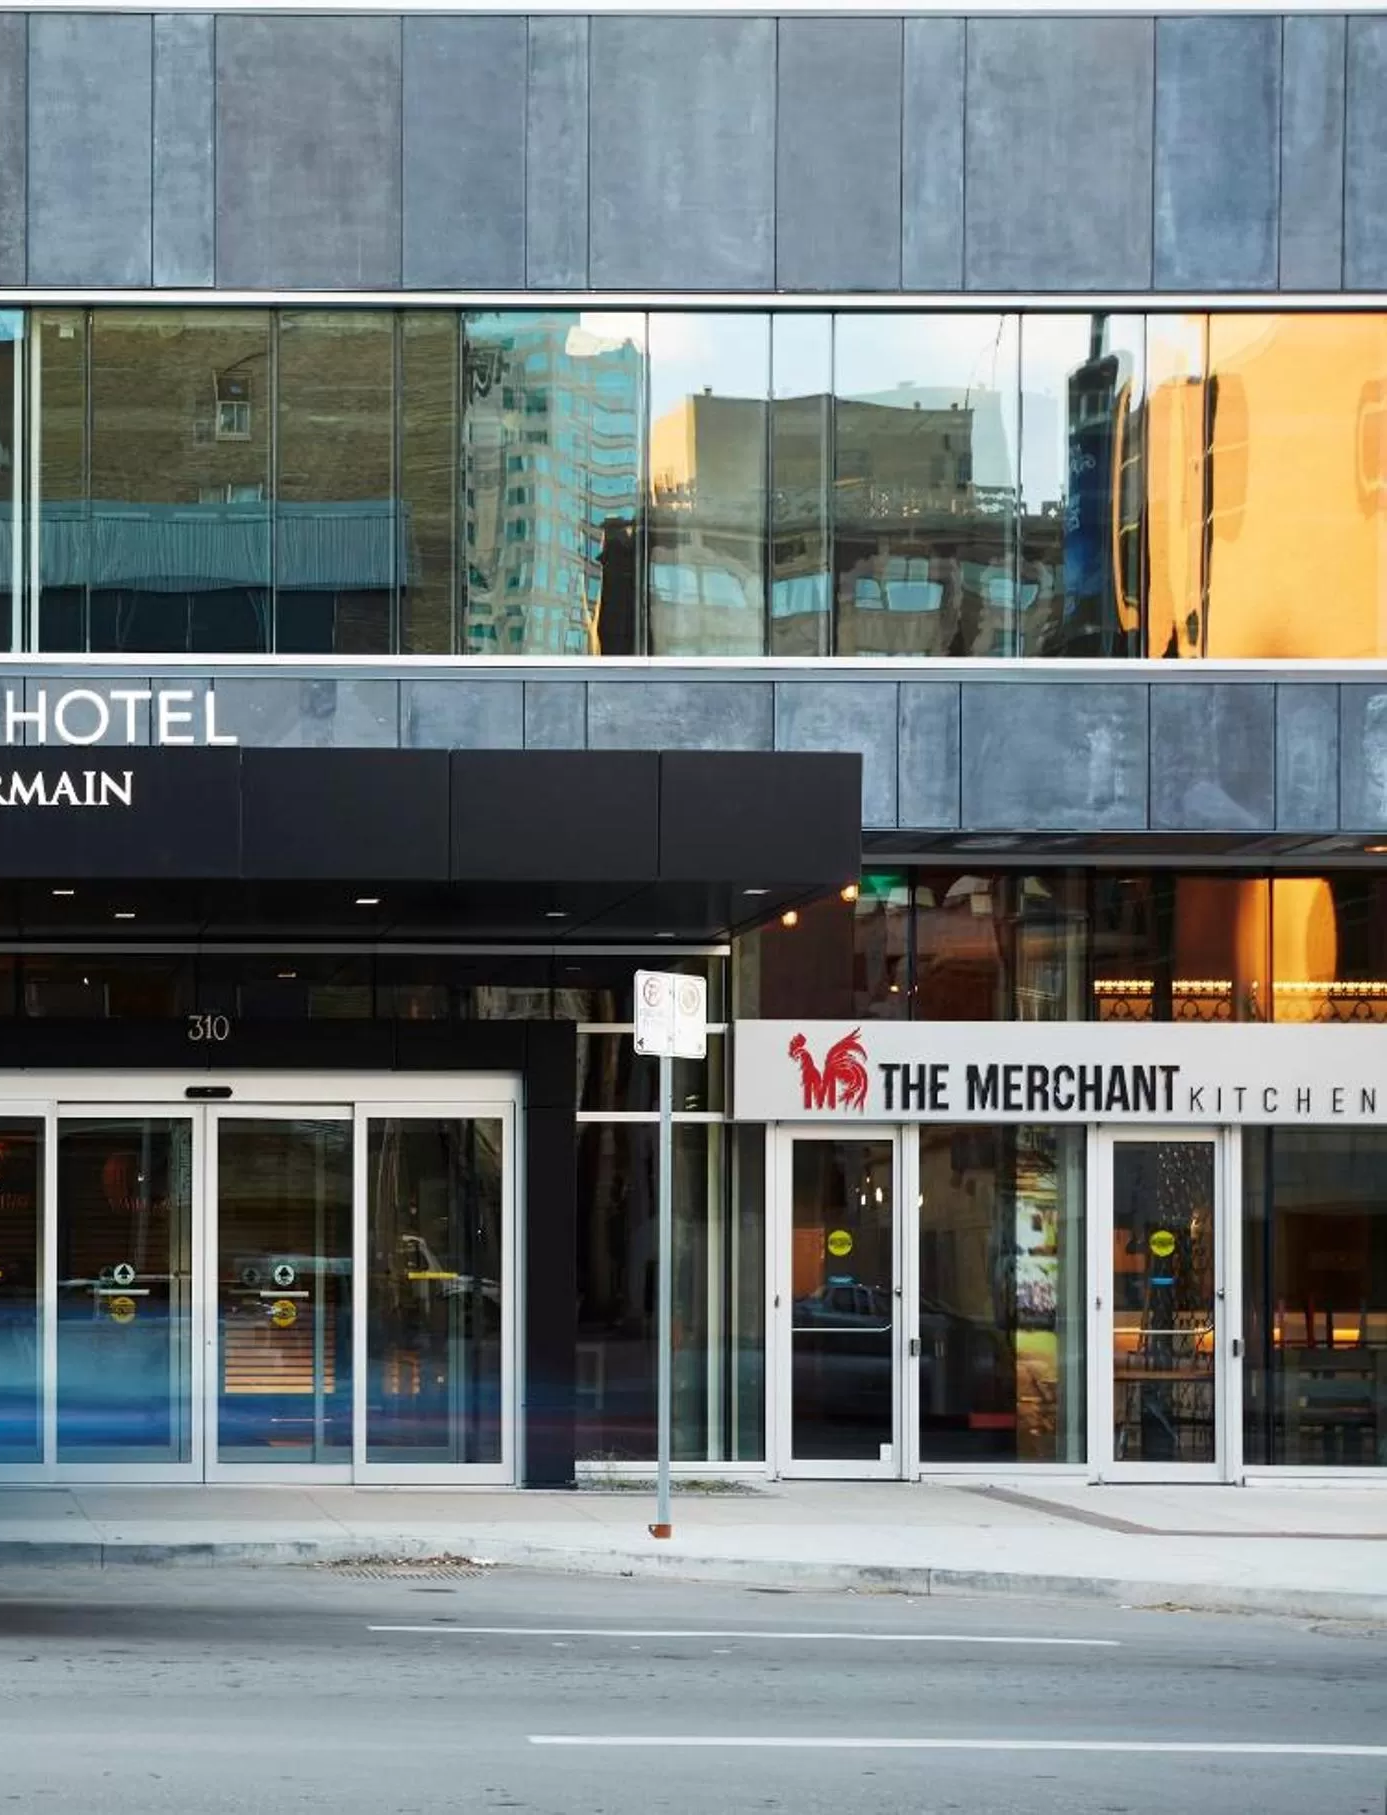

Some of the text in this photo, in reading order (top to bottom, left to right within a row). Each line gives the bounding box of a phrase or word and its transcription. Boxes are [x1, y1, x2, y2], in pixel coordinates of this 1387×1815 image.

[6, 689, 239, 746] HOTEL
[188, 1014, 230, 1041] 310
[878, 1063, 1376, 1115] THE MERCHANT KITCHEN
